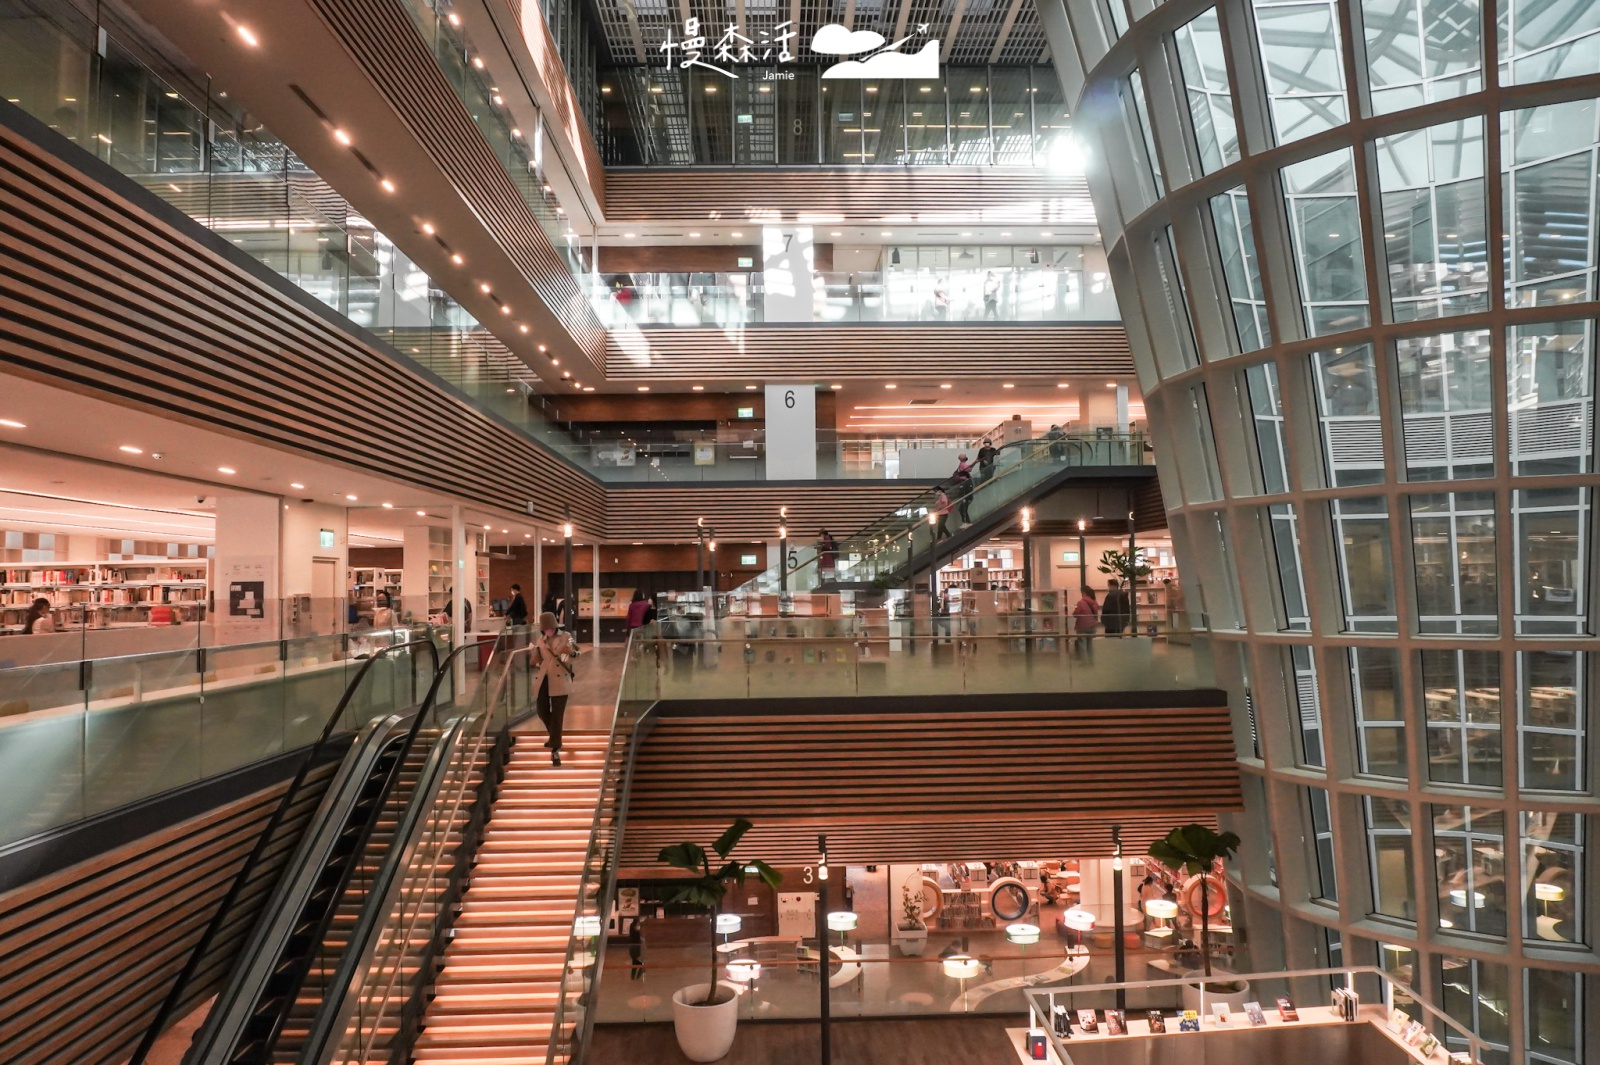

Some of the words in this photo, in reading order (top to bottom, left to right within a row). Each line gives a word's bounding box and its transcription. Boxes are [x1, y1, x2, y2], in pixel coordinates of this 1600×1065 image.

[793, 119, 802, 135] 8
[783, 234, 793, 252] 7
[785, 390, 795, 408] 6
[787, 551, 798, 569] 5
[803, 866, 813, 884] 3
